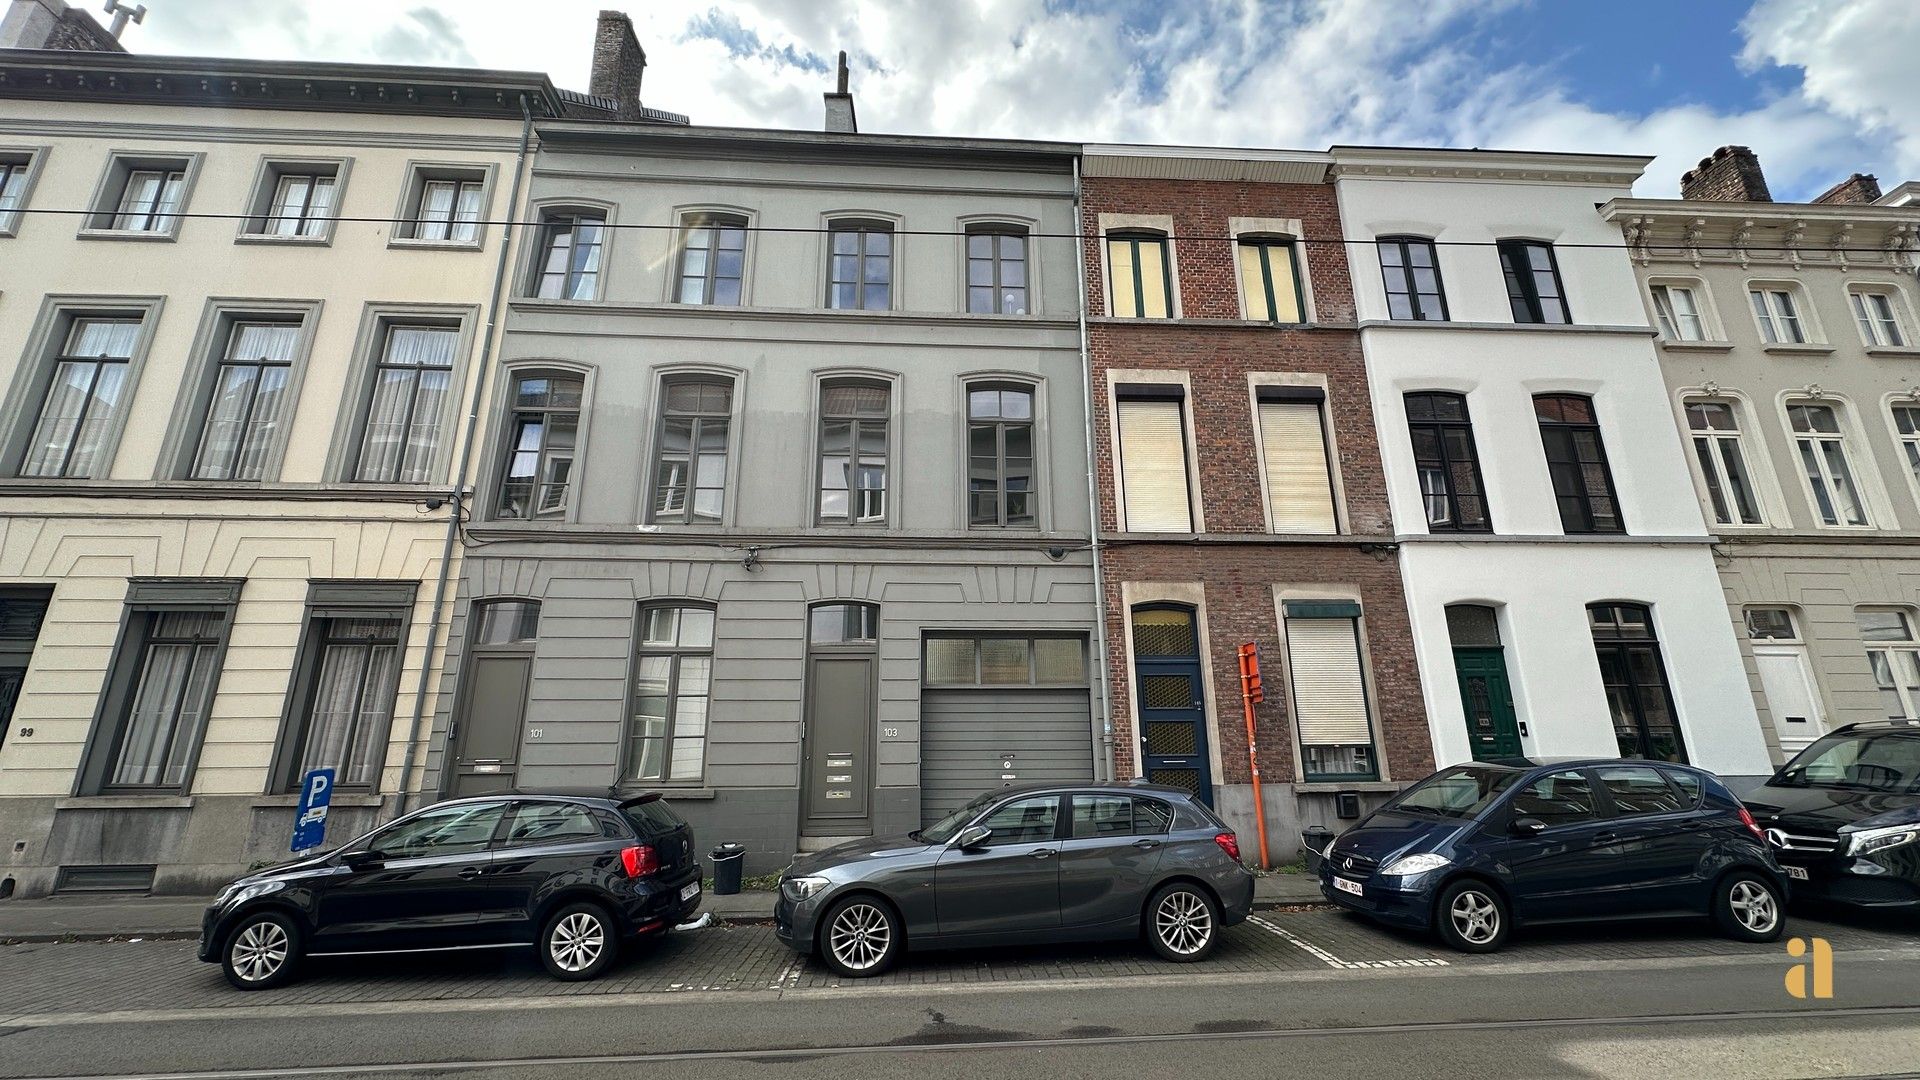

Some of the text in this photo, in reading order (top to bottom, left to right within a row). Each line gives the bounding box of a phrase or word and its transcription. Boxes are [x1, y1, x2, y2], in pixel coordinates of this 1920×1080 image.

[20, 727, 34, 737] 99
[530, 729, 543, 738] 101
[884, 728, 898, 737] 103
[307, 775, 328, 807] P
